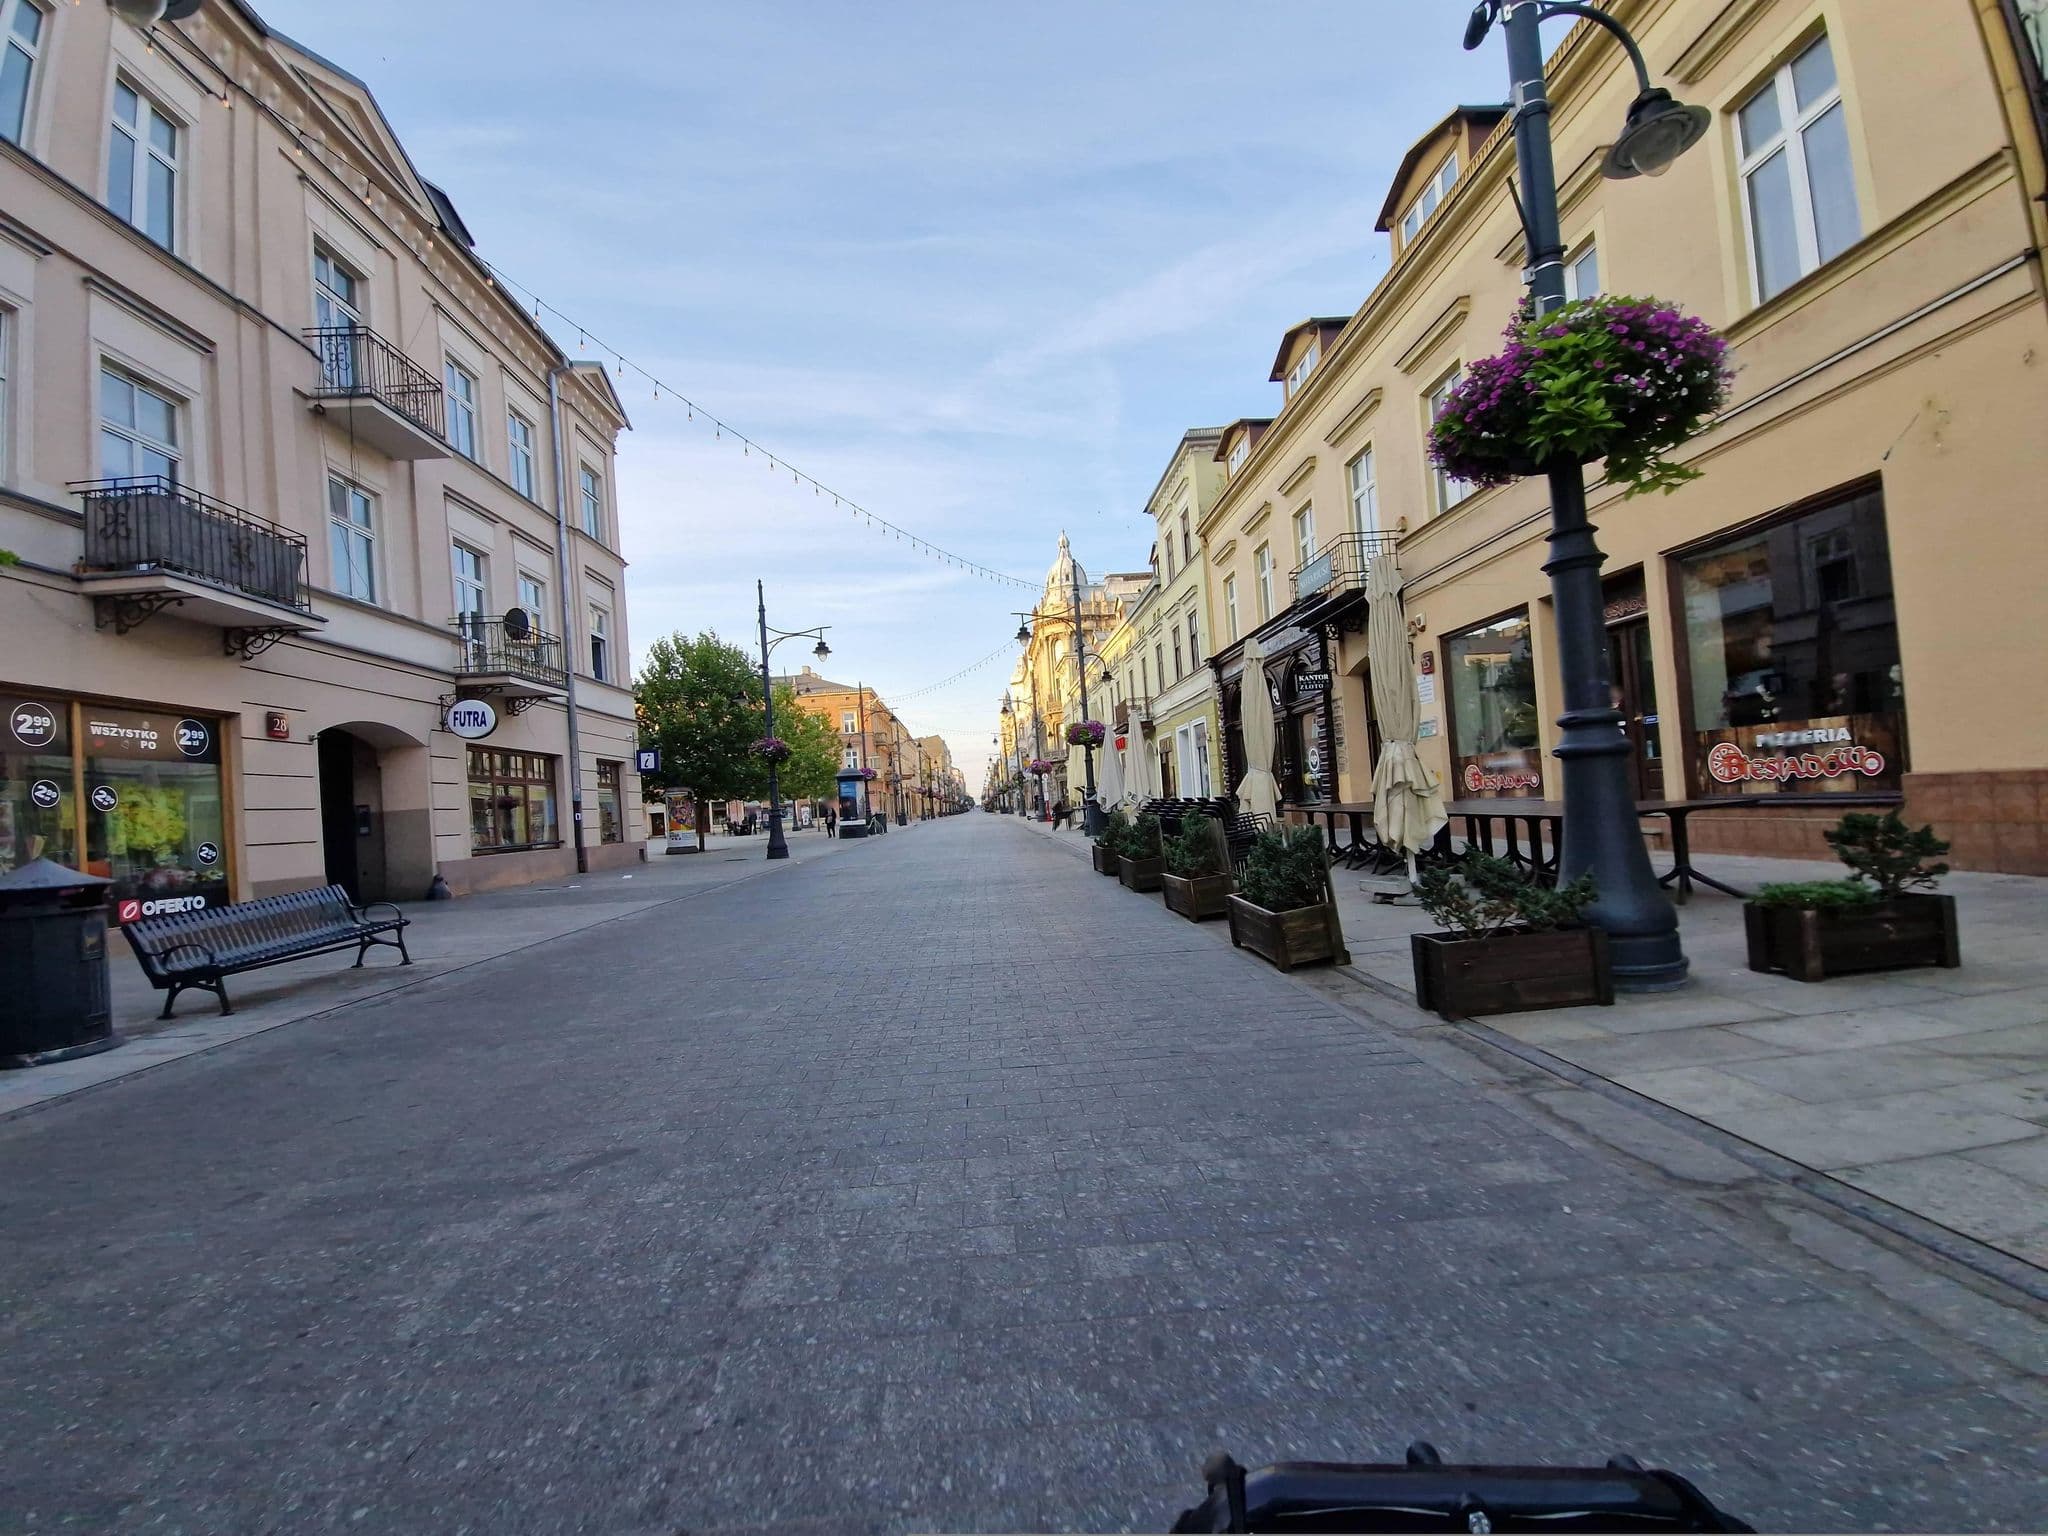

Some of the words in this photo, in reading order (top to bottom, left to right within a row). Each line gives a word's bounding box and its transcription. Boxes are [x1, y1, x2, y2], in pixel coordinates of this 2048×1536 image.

[1299, 673, 1329, 682] KANTOR
[273, 718, 287, 731] 28
[453, 710, 487, 727] FUTRA
[90, 725, 158, 740] WSZYSTKO
[140, 740, 157, 750] PO
[141, 895, 206, 916] OFERTO
